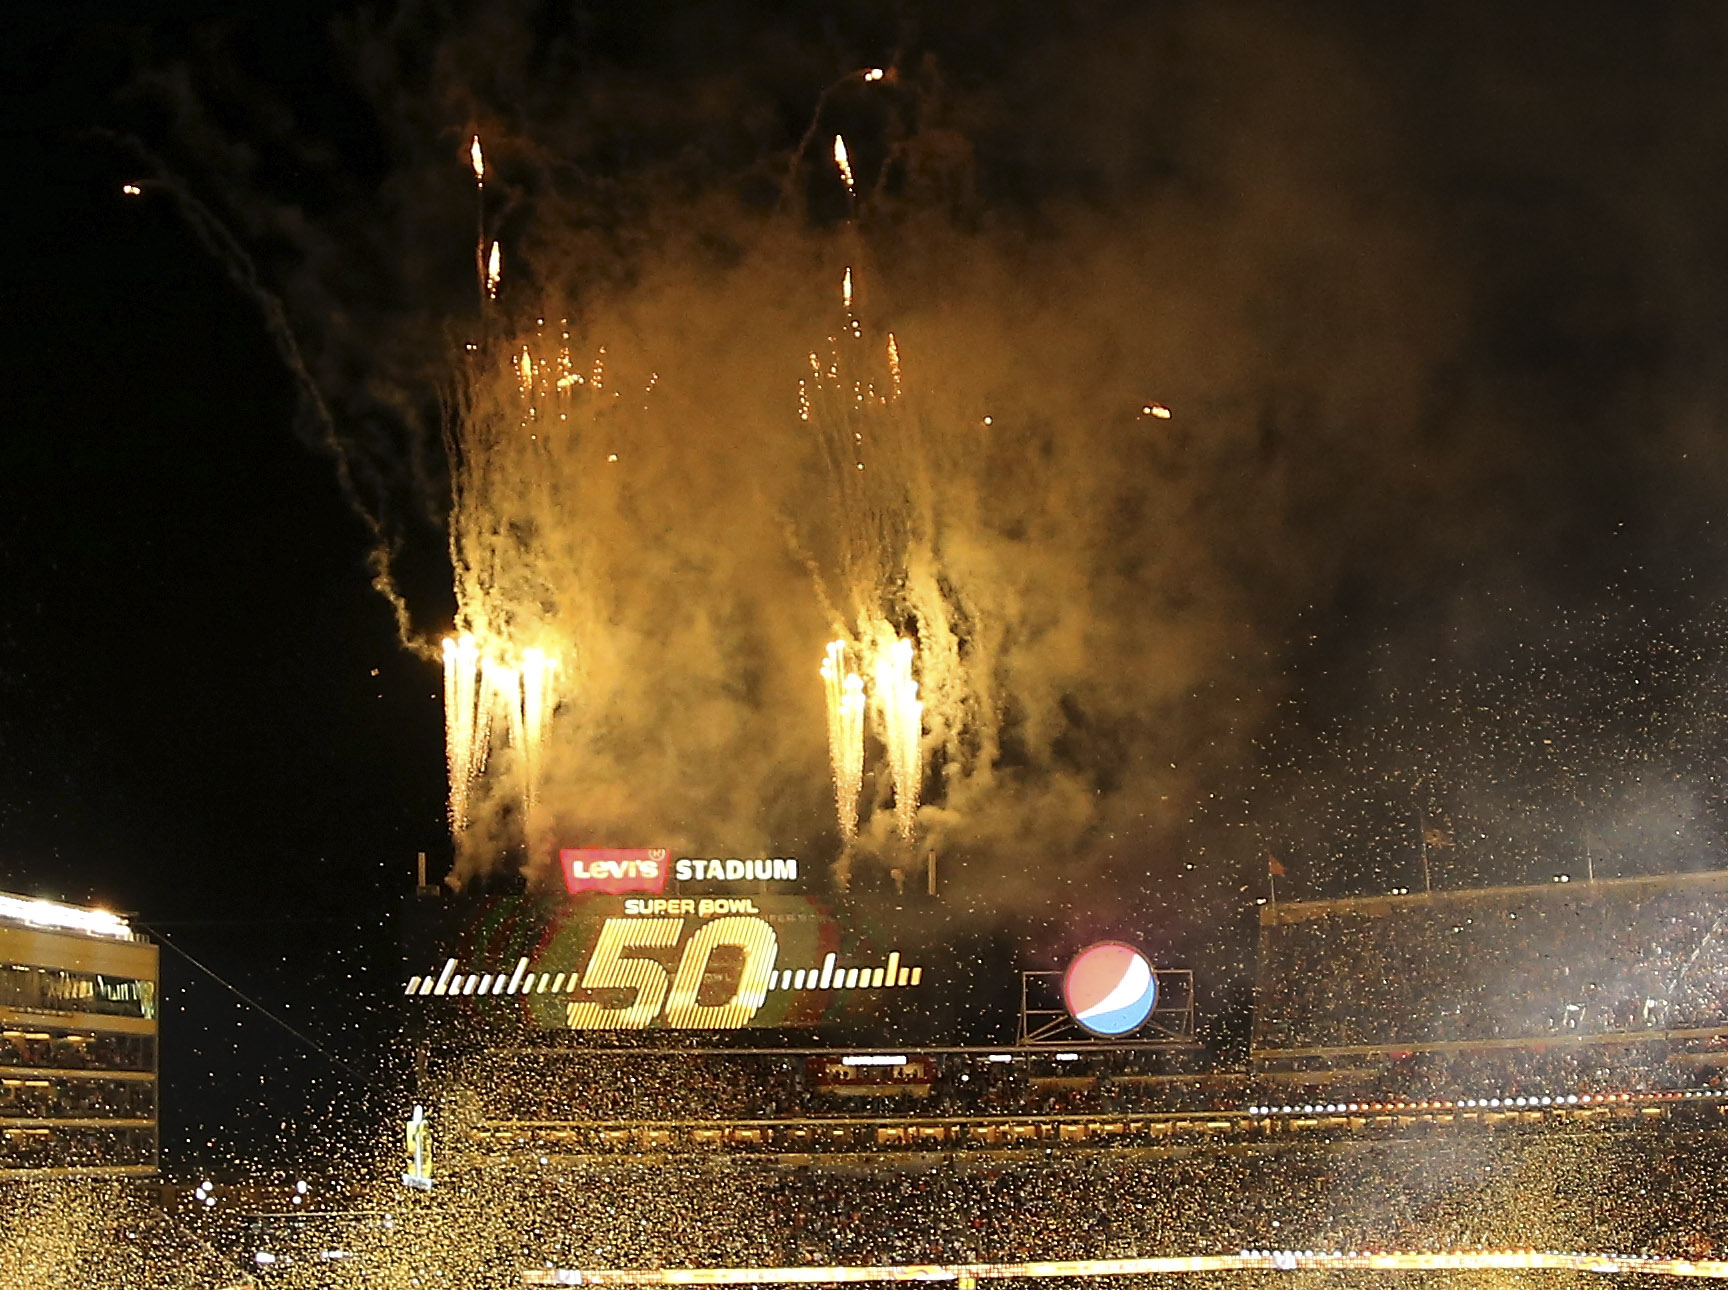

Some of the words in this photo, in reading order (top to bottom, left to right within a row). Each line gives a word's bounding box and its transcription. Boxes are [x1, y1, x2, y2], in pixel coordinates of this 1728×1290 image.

[675, 858, 798, 881] STADIUM
[624, 898, 695, 915] SUPER
[698, 898, 759, 916] BOWL
[566, 918, 778, 1029] 50
